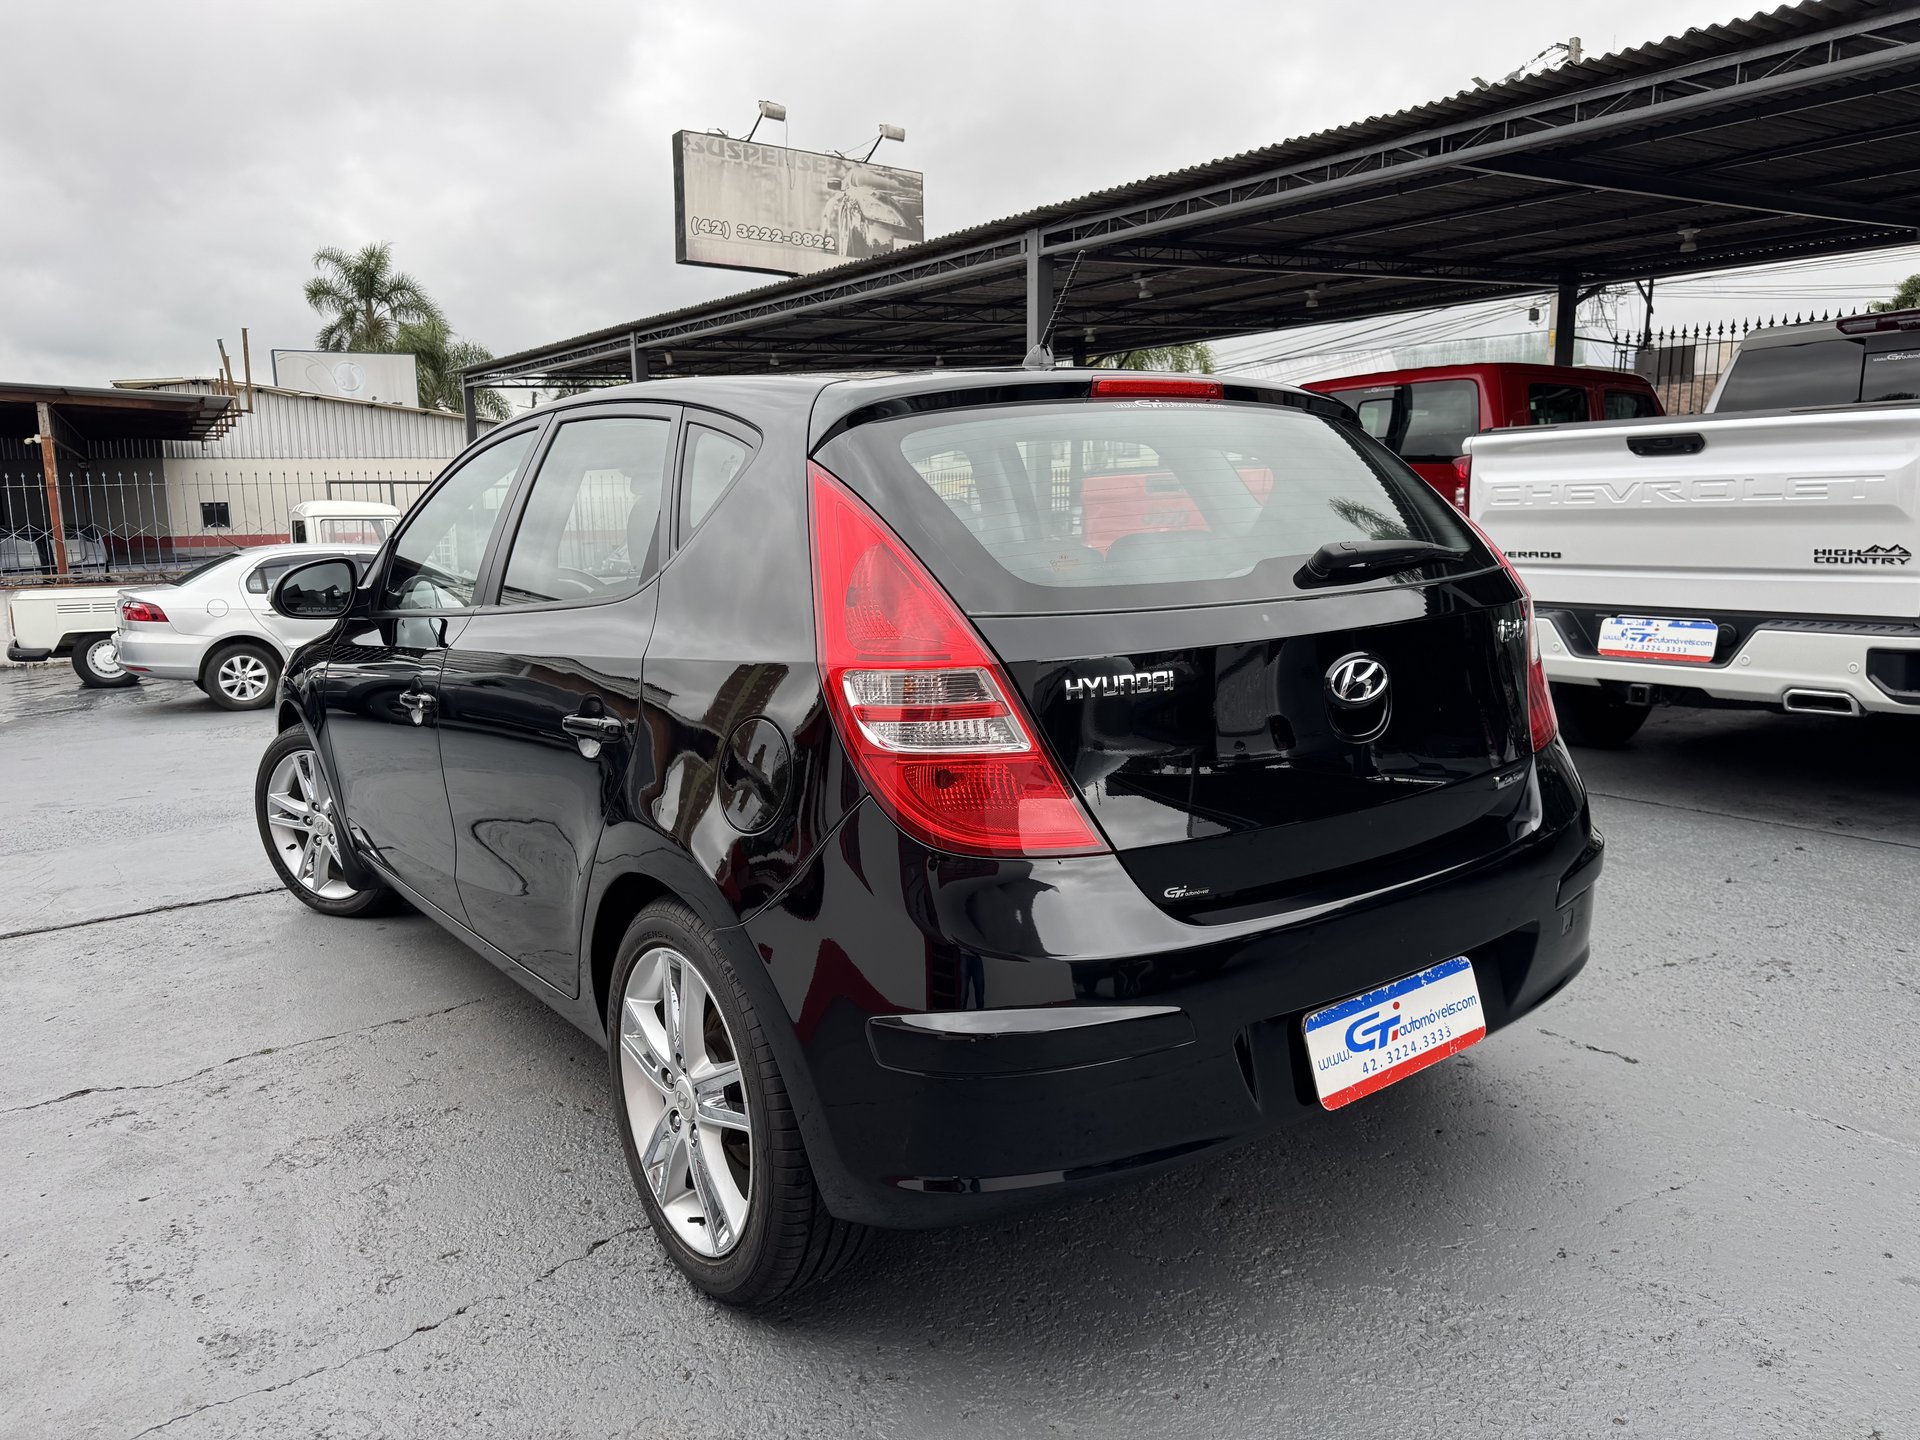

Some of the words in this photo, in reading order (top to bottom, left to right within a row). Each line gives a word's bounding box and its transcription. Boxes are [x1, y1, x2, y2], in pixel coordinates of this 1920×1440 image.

[691, 216, 731, 239] (42)
[736, 224, 836, 250] 3222-8822
[1491, 475, 1886, 505] CHEVROLET
[1813, 548, 1862, 557] HIGH
[1813, 556, 1911, 566] COUNTRY
[1065, 670, 1176, 700] HYUNDAI
[1362, 1025, 1452, 1074] 42.3224.3333
